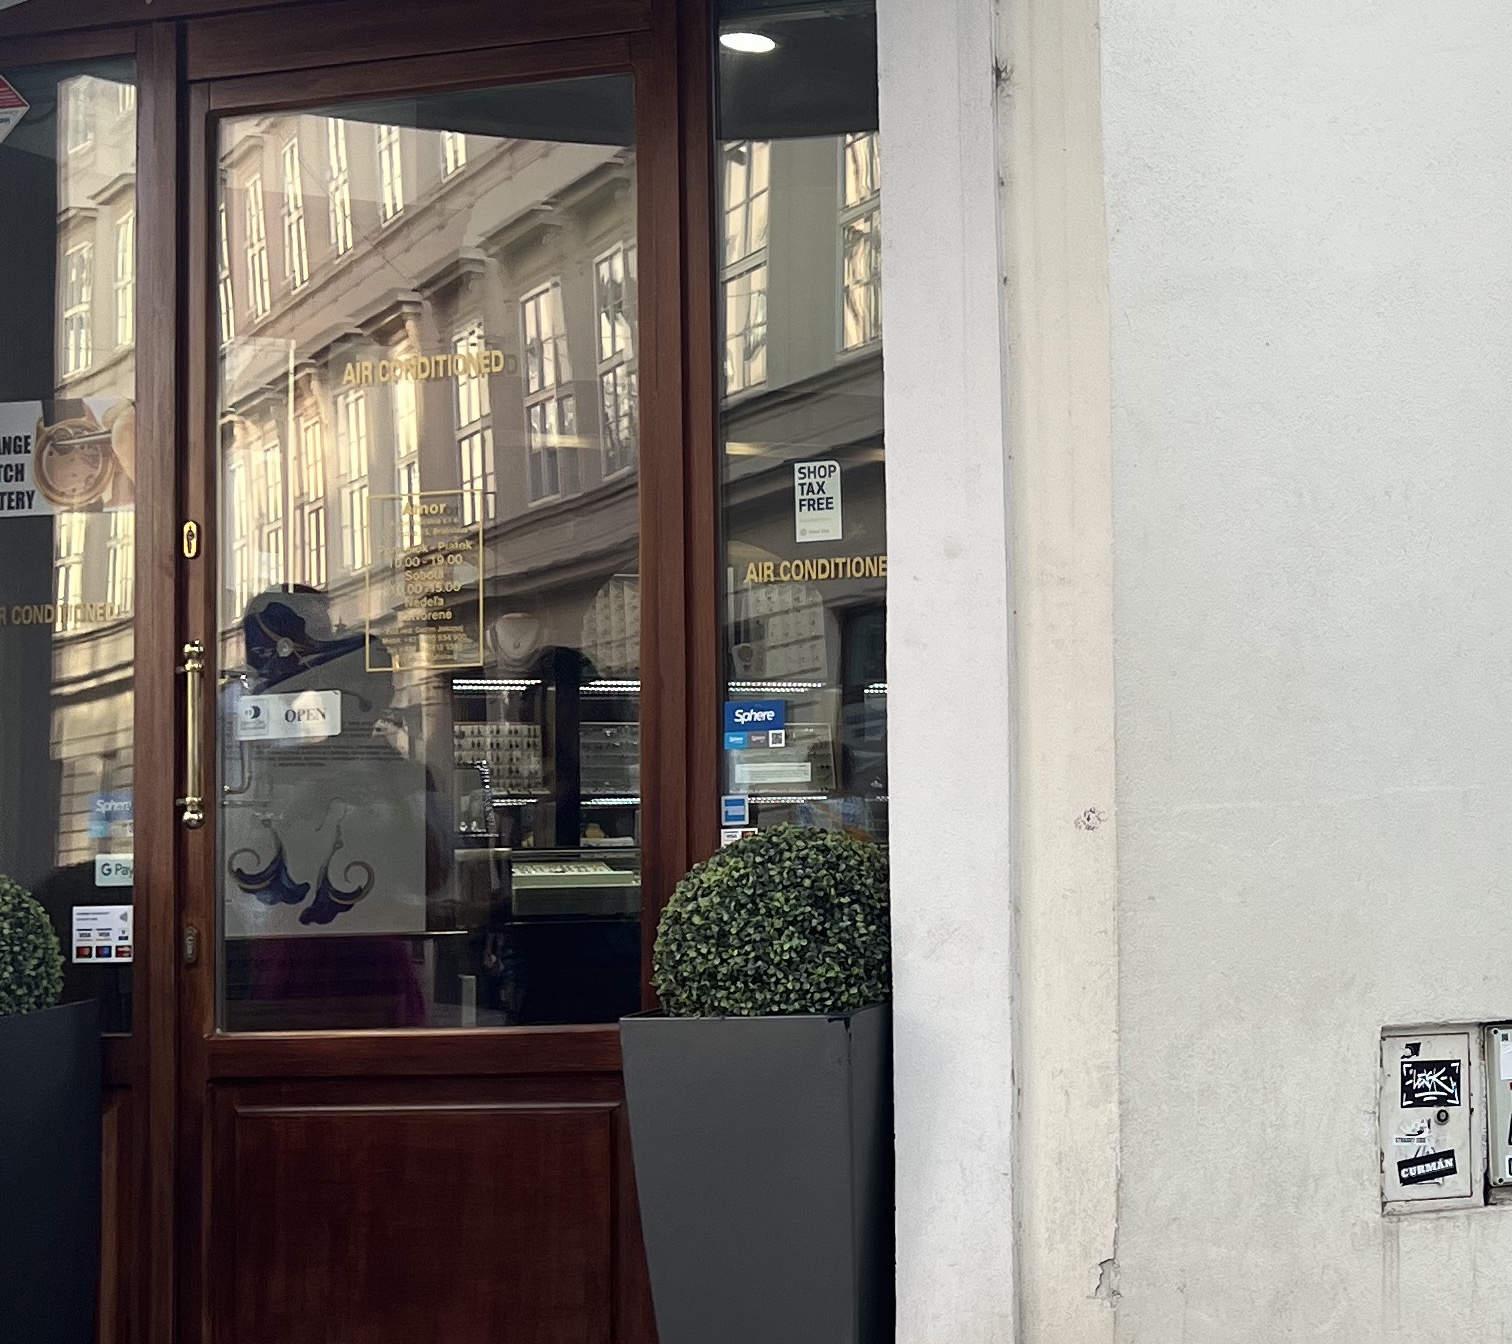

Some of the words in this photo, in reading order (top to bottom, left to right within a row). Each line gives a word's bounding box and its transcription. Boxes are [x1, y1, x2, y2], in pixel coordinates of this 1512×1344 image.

[342, 361, 374, 386] AIR
[378, 349, 505, 383] CONDITIONED
[0, 434, 32, 455] NGE
[797, 464, 837, 481] SHOP
[797, 481, 826, 497] TAX
[798, 496, 834, 513] FREE
[743, 561, 775, 585] AIR
[779, 555, 887, 582] CONDITIONE
[284, 707, 327, 723] OPEN
[734, 709, 776, 725] Sphere
[1400, 1156, 1454, 1179] CURMÁN
